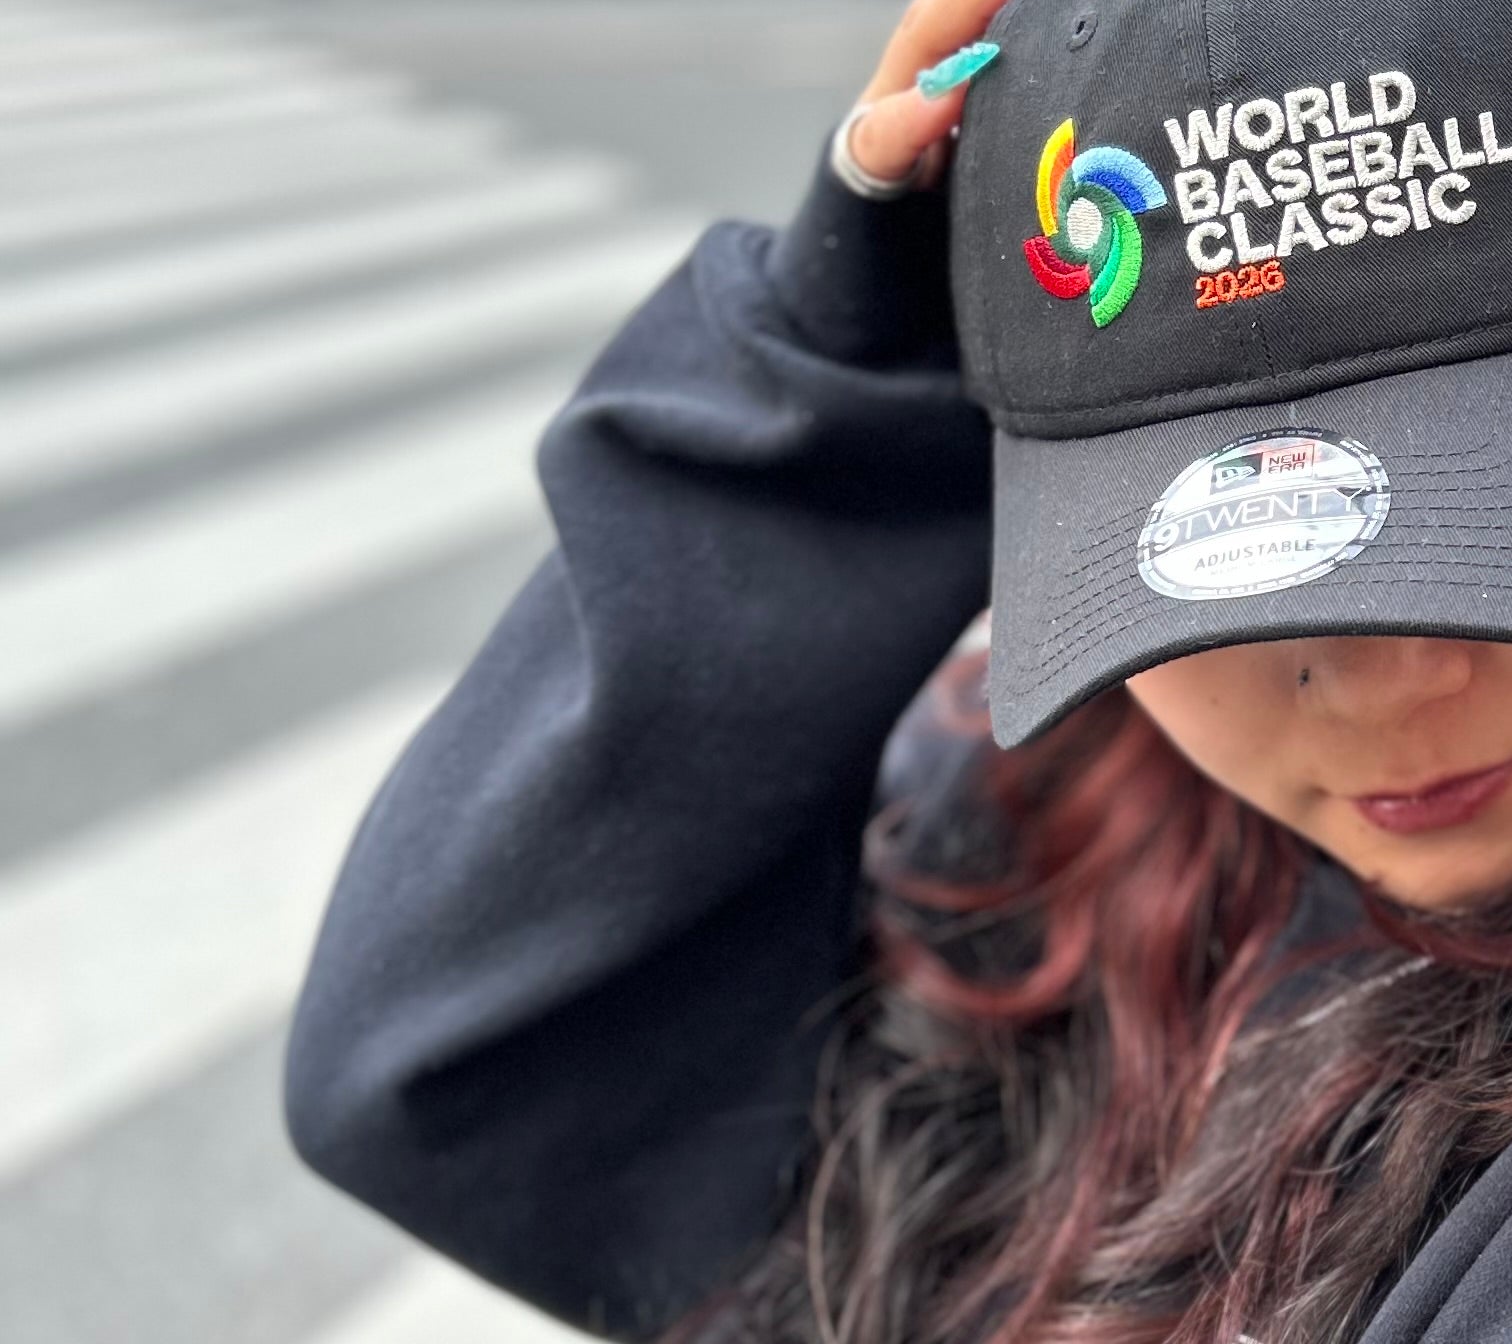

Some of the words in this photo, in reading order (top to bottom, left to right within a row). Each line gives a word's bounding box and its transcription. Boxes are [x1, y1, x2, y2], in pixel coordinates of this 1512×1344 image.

[1164, 71, 1416, 168] WORLD
[1186, 172, 1477, 273] CLASSIC
[1195, 258, 1287, 309] 2026
[1268, 452, 1306, 465] NEW
[1268, 462, 1305, 474] ERA
[1153, 486, 1369, 552] 9TWENTY
[1194, 538, 1316, 571] ADJUSTABLE
